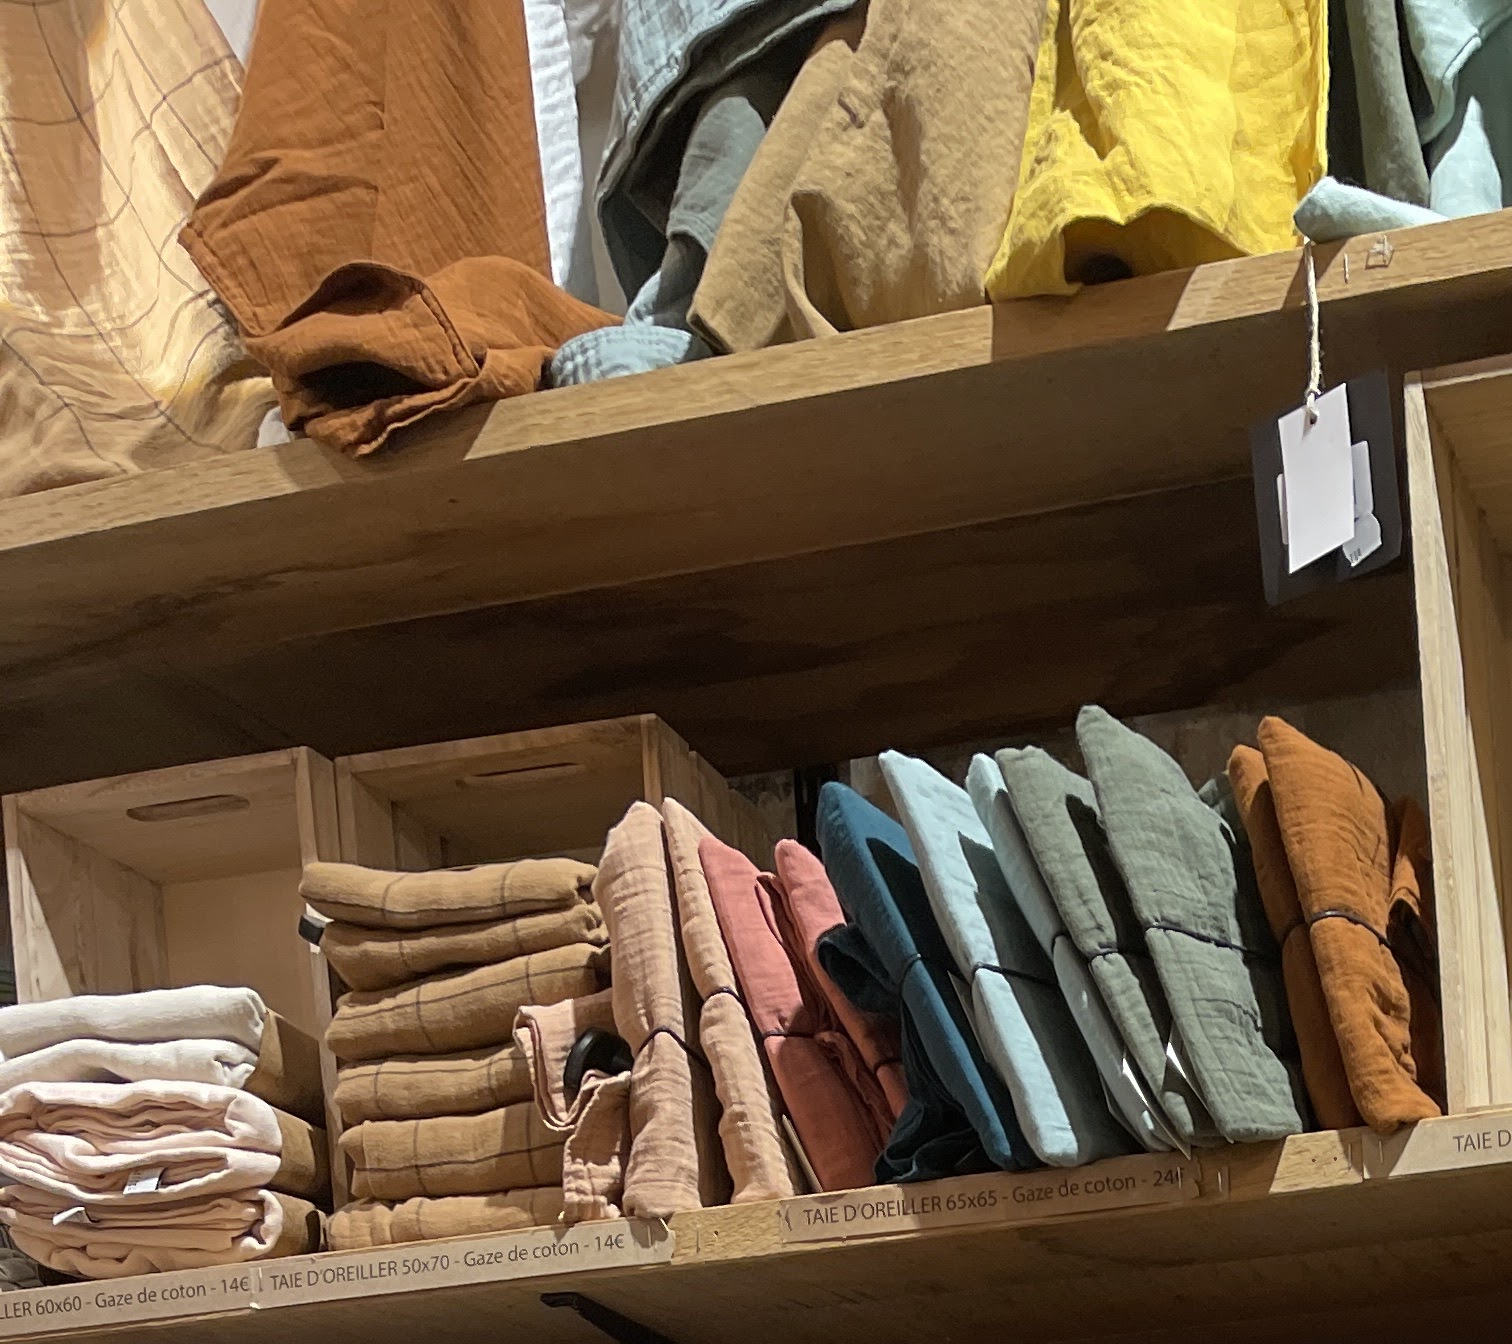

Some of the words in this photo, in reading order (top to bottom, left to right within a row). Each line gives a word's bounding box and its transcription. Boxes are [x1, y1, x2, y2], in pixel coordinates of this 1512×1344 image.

[1452, 1131, 1492, 1153] TAIE
[802, 1206, 839, 1226] TAIE
[843, 1195, 942, 1222] D'OREILLER
[946, 1189, 997, 1211] 65x65
[1012, 1185, 1053, 1204] Gaze
[1058, 1179, 1079, 1198] de
[1084, 1176, 1136, 1195] coton
[269, 1271, 303, 1291] TAIE
[307, 1260, 397, 1287] D'OREILLER
[402, 1254, 449, 1275] 50x70
[464, 1250, 504, 1267] Gaze
[507, 1244, 529, 1262] de
[532, 1242, 579, 1259] coton
[595, 1233, 625, 1252] 14€
[0, 1300, 33, 1320] LER
[35, 1295, 82, 1316] 60x60
[95, 1292, 133, 1309] Gaze
[137, 1286, 157, 1304] de
[161, 1284, 206, 1301] coton
[221, 1276, 249, 1294] 14€
